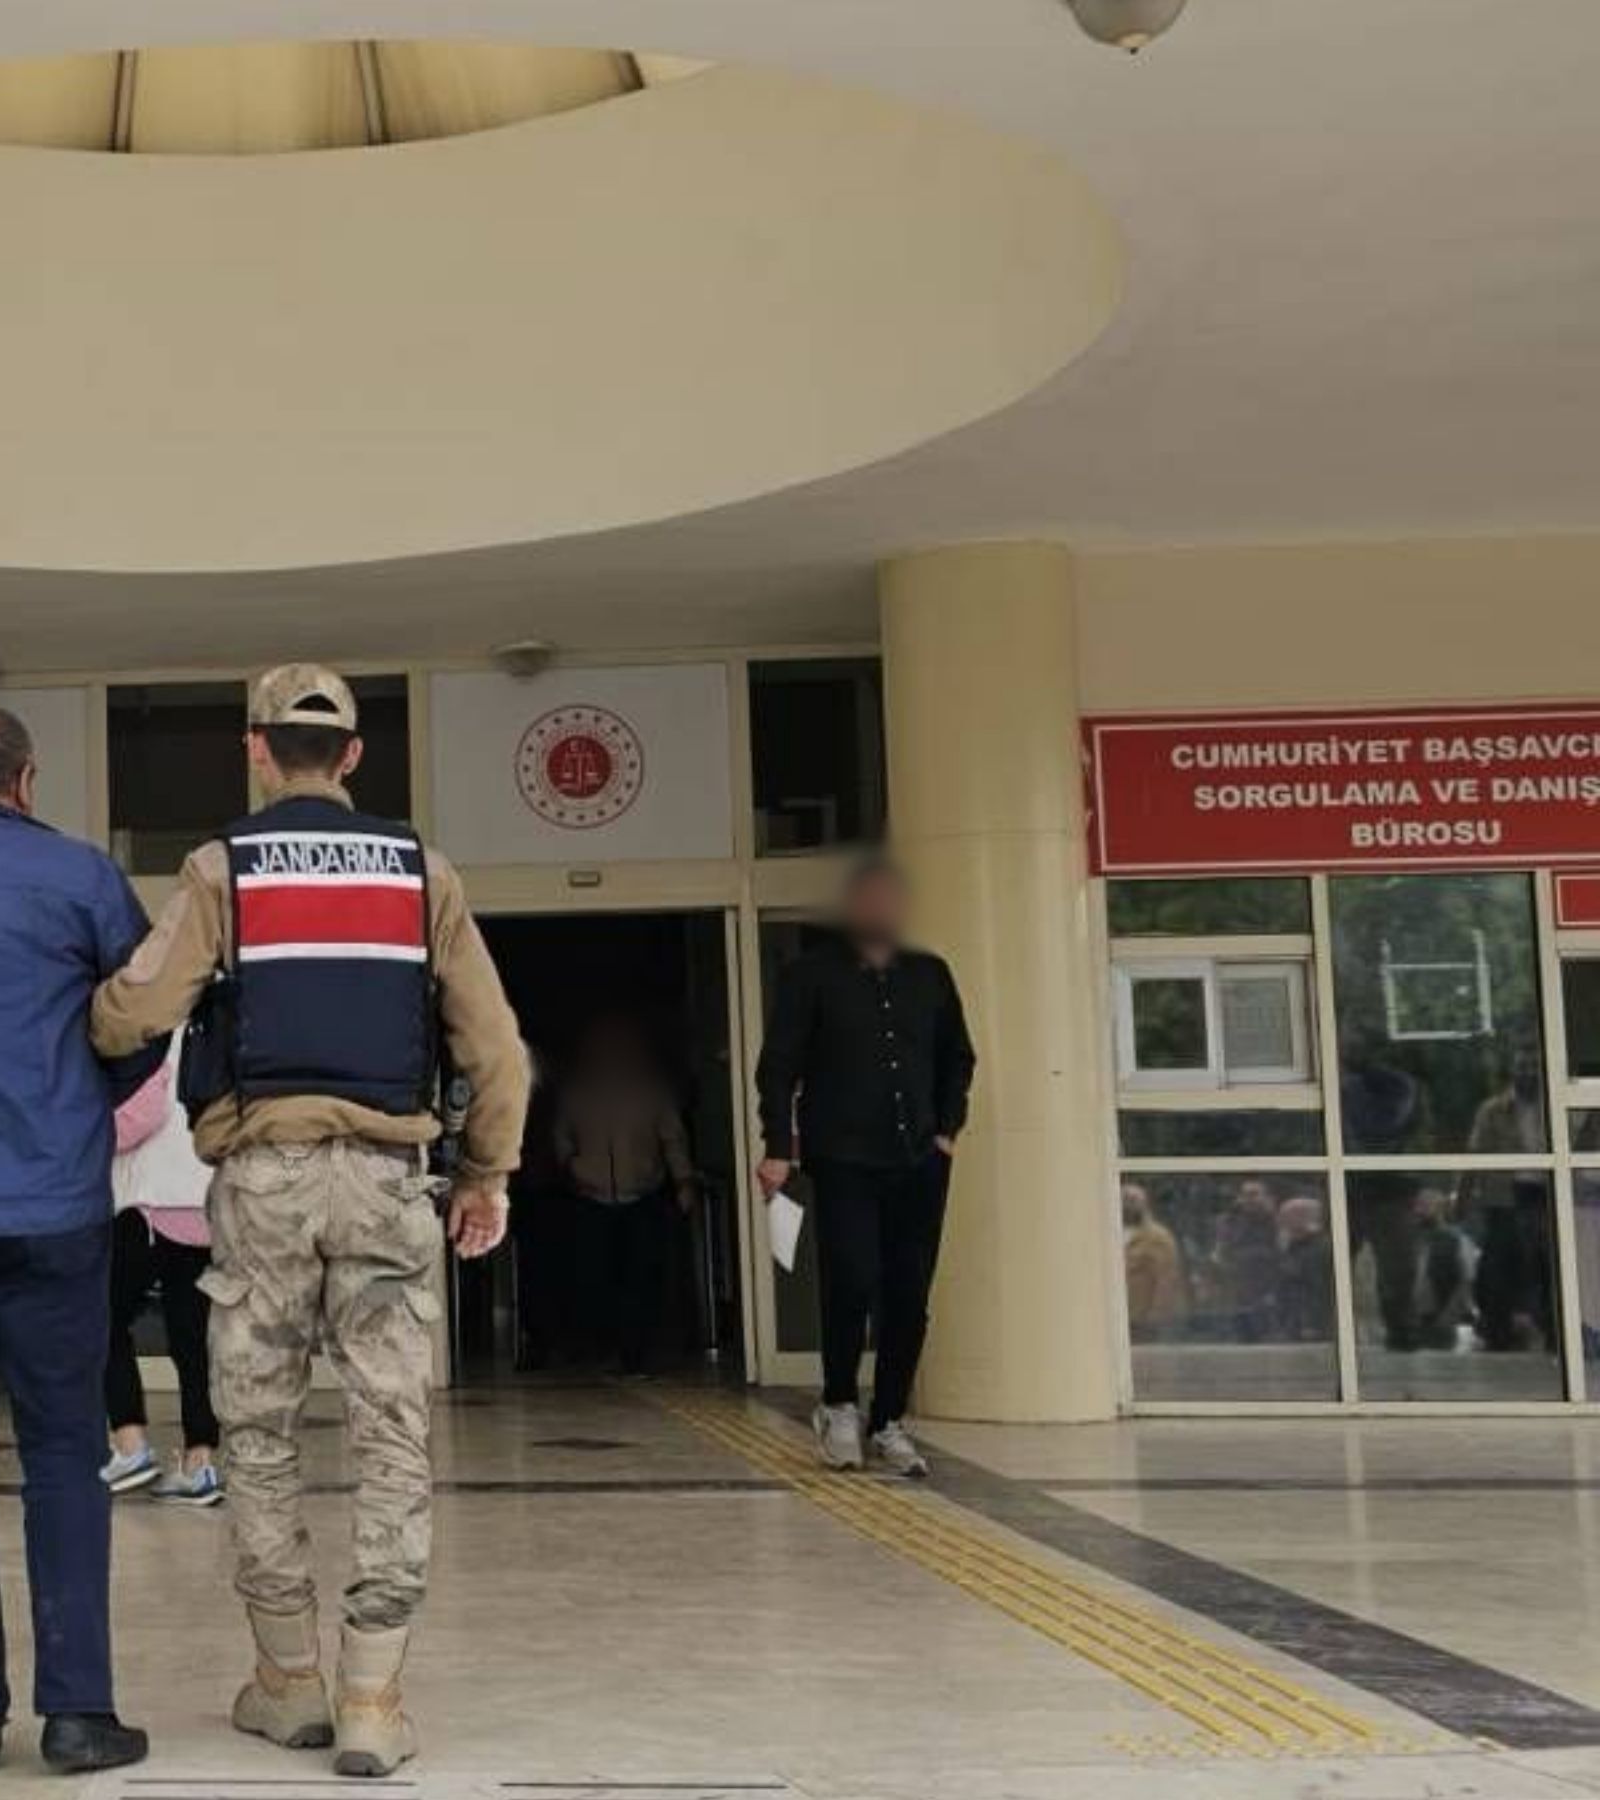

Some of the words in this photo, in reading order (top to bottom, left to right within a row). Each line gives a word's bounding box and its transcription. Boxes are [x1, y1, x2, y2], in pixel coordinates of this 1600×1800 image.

[1170, 736, 1412, 769] CUMHURİYET
[1194, 779, 1421, 810] SORGULAMA
[1431, 778, 1480, 803] VE
[1491, 776, 1600, 806] DANIŞ
[1351, 820, 1502, 848] BÜROSU
[252, 842, 405, 874] JANDARMA
